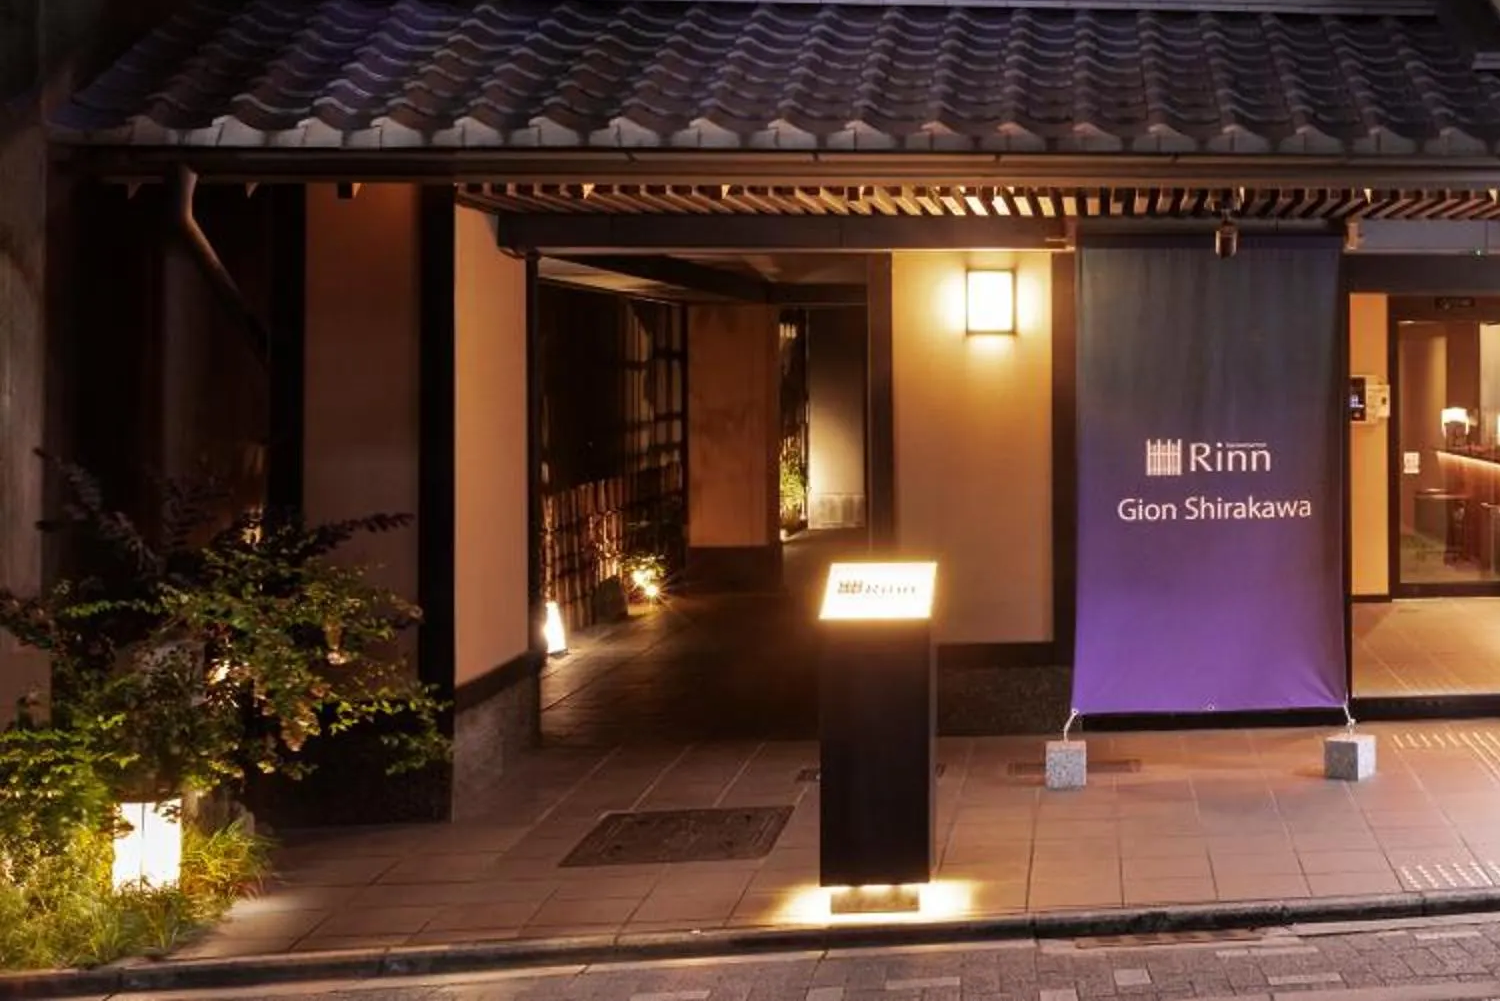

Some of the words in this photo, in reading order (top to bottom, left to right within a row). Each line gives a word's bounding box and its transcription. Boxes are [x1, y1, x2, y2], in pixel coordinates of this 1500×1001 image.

[1190, 442, 1271, 472] Rinn
[1117, 498, 1177, 520] Gion
[1185, 496, 1312, 520] Shirakawa
